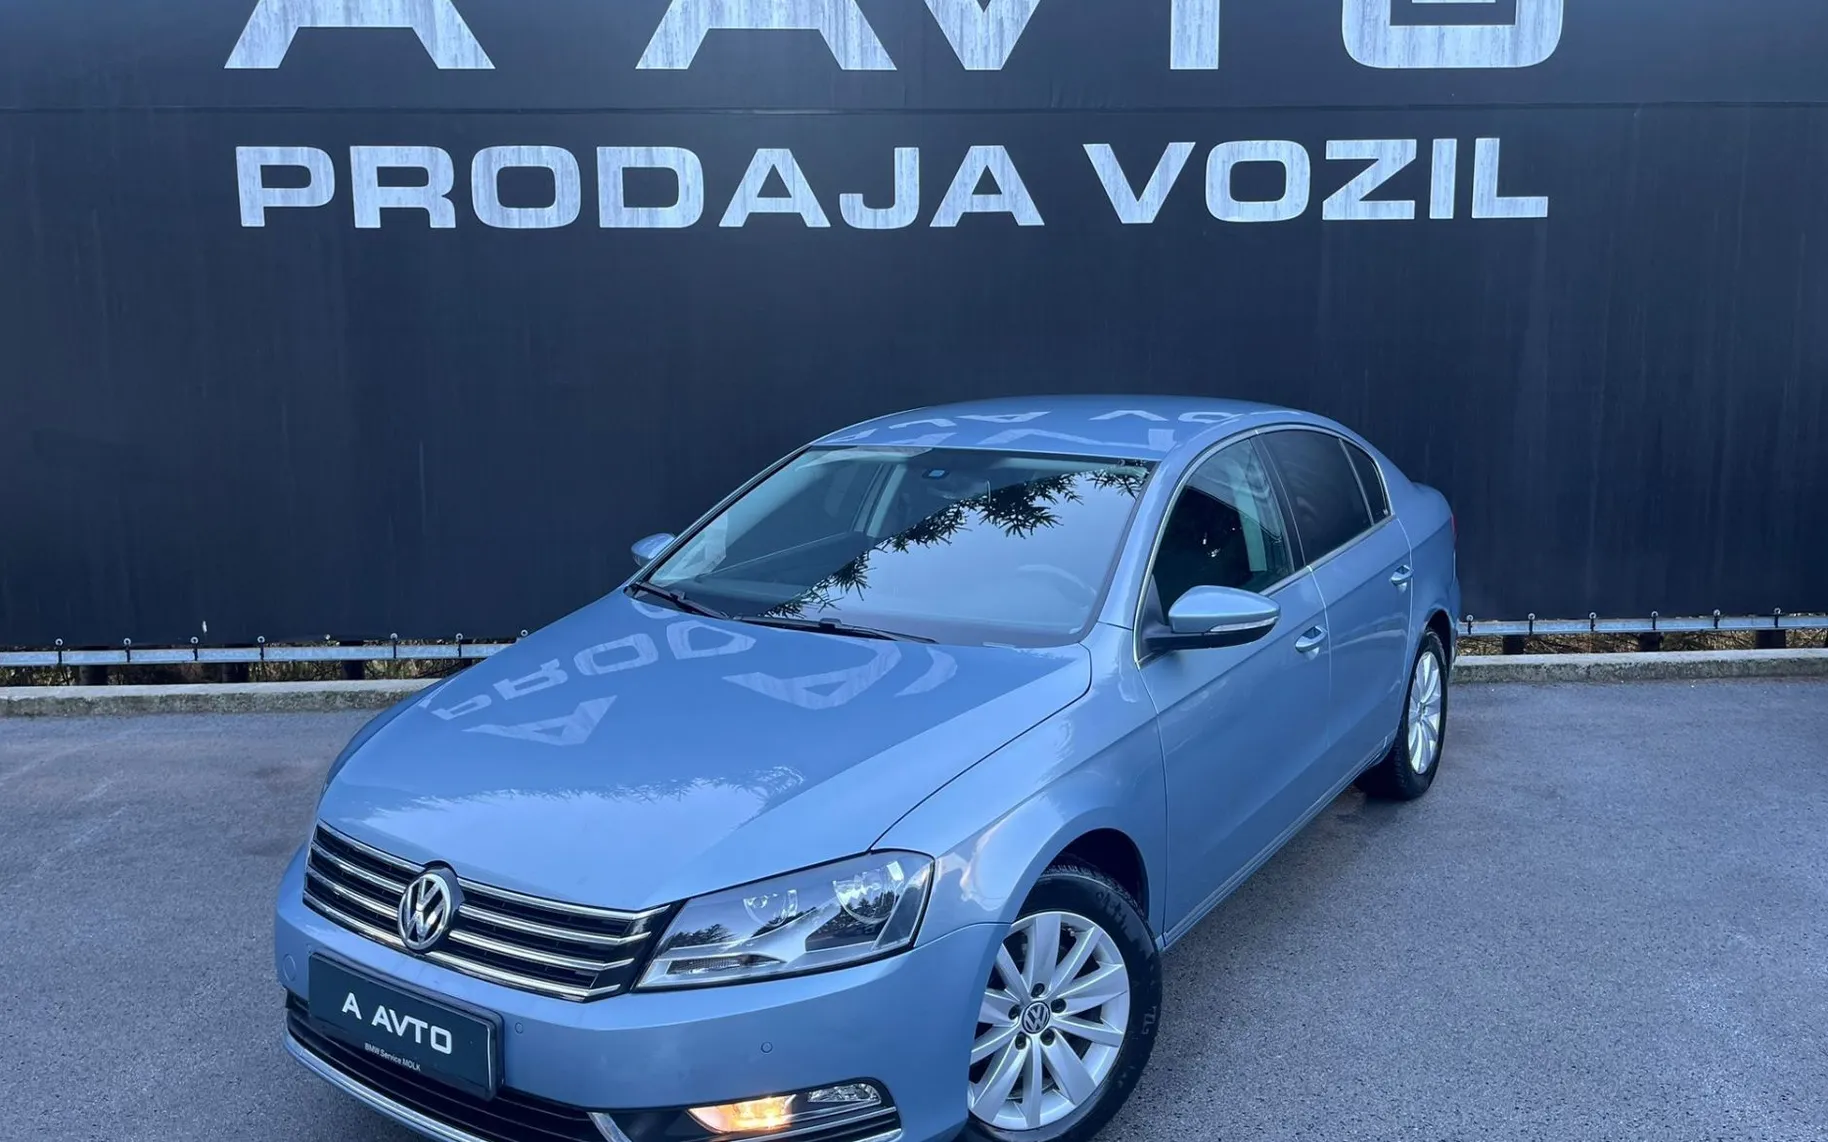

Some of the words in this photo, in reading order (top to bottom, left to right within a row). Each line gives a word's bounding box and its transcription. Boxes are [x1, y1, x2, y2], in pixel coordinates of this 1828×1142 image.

[235, 145, 1045, 229] PRODAJA
[1082, 138, 1549, 224] VOZIL
[341, 992, 362, 1020] A
[371, 1005, 453, 1055] AVTO
[380, 1048, 402, 1065] Service
